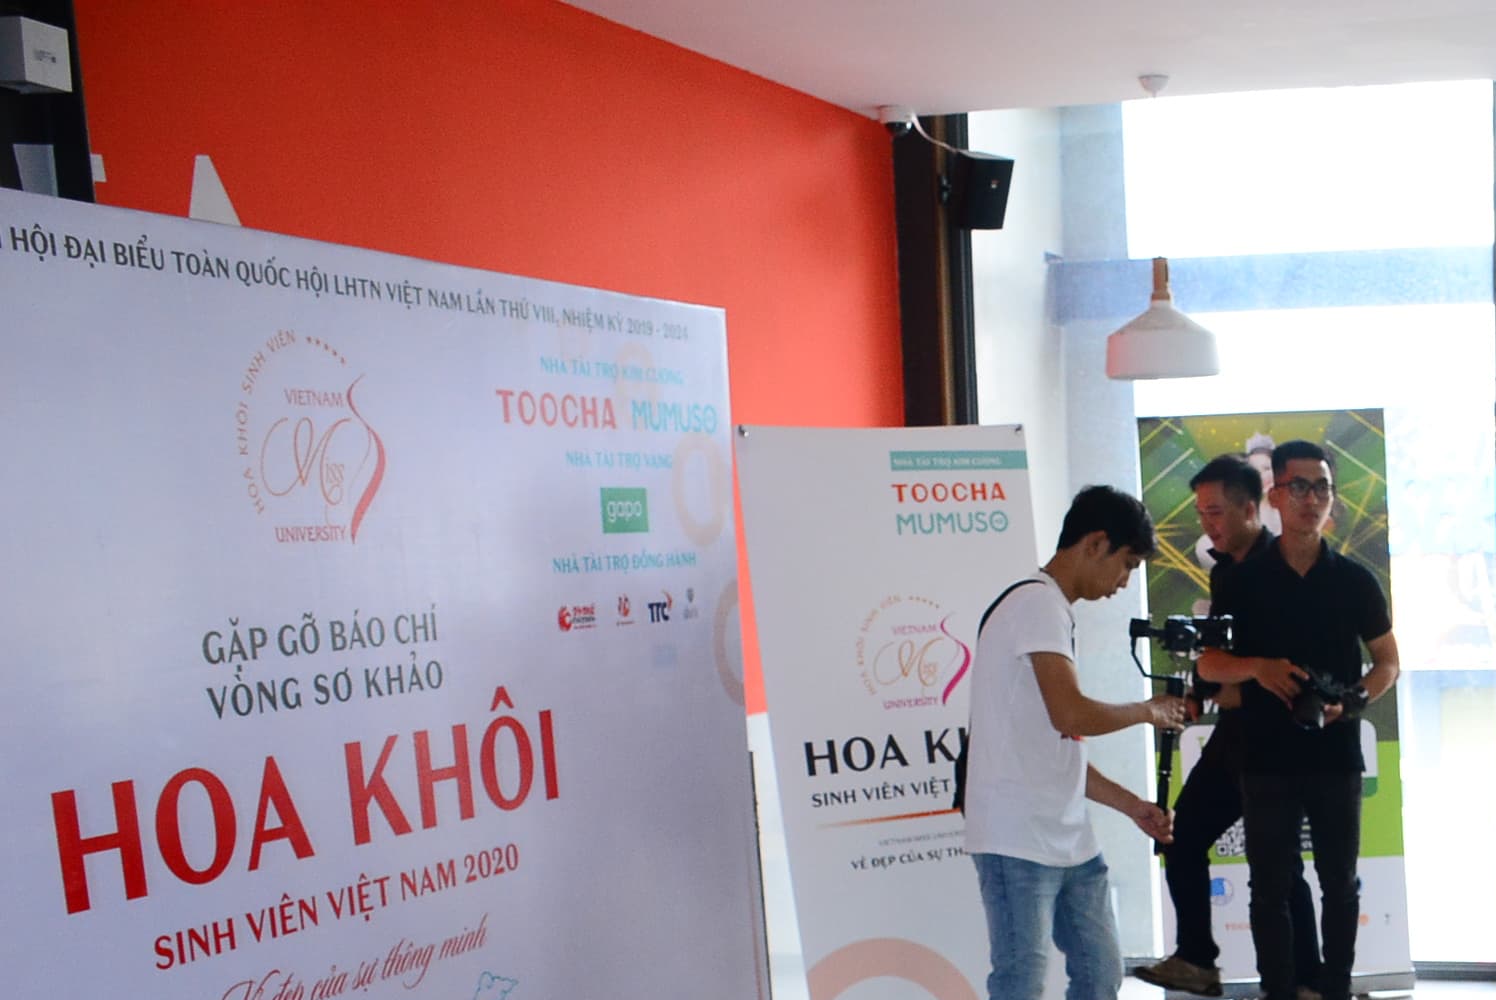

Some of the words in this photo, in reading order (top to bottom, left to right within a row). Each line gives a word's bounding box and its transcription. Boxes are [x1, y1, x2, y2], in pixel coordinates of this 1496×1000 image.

[10, 224, 57, 262] HỘI
[64, 235, 106, 268] ĐẠI
[114, 234, 165, 271] BIỂU
[171, 249, 230, 279] TOÀN
[236, 256, 291, 287] QUỐC
[296, 266, 328, 298] HỘI
[334, 275, 381, 300] LHTN
[386, 280, 422, 309] VIỆT
[428, 289, 463, 311] NAM
[500, 297, 529, 320] THỨ
[284, 388, 343, 407] VIETNAM
[496, 389, 617, 430] TOOCHA
[631, 399, 718, 434] MUMUSO
[607, 500, 642, 522] gapo
[891, 482, 1006, 503] TOOCHA
[274, 524, 346, 543] UNIVERSITY
[896, 510, 1009, 536] MUMUSO
[648, 602, 669, 623] TTC
[202, 617, 267, 672] GẶP
[278, 612, 320, 656] GỖ
[329, 609, 385, 651] BÁO
[394, 604, 438, 644] CHÍ
[206, 674, 302, 720] VÒNG
[313, 667, 352, 705] SƠ
[364, 651, 443, 699] KHẢO
[804, 733, 909, 777] HOA
[51, 755, 315, 915] HOA
[344, 686, 559, 846] KHÔI
[812, 789, 857, 808] SINH
[862, 781, 906, 801] VIÊN
[911, 776, 951, 799] VIỆT
[154, 918, 236, 970] SINH
[246, 893, 319, 942] VIÊN
[327, 872, 391, 922] VIỆT
[400, 859, 457, 900] NAM
[464, 843, 520, 884] 2020
[352, 958, 380, 992] sự
[381, 937, 435, 990] thông
[438, 912, 489, 960] minh
